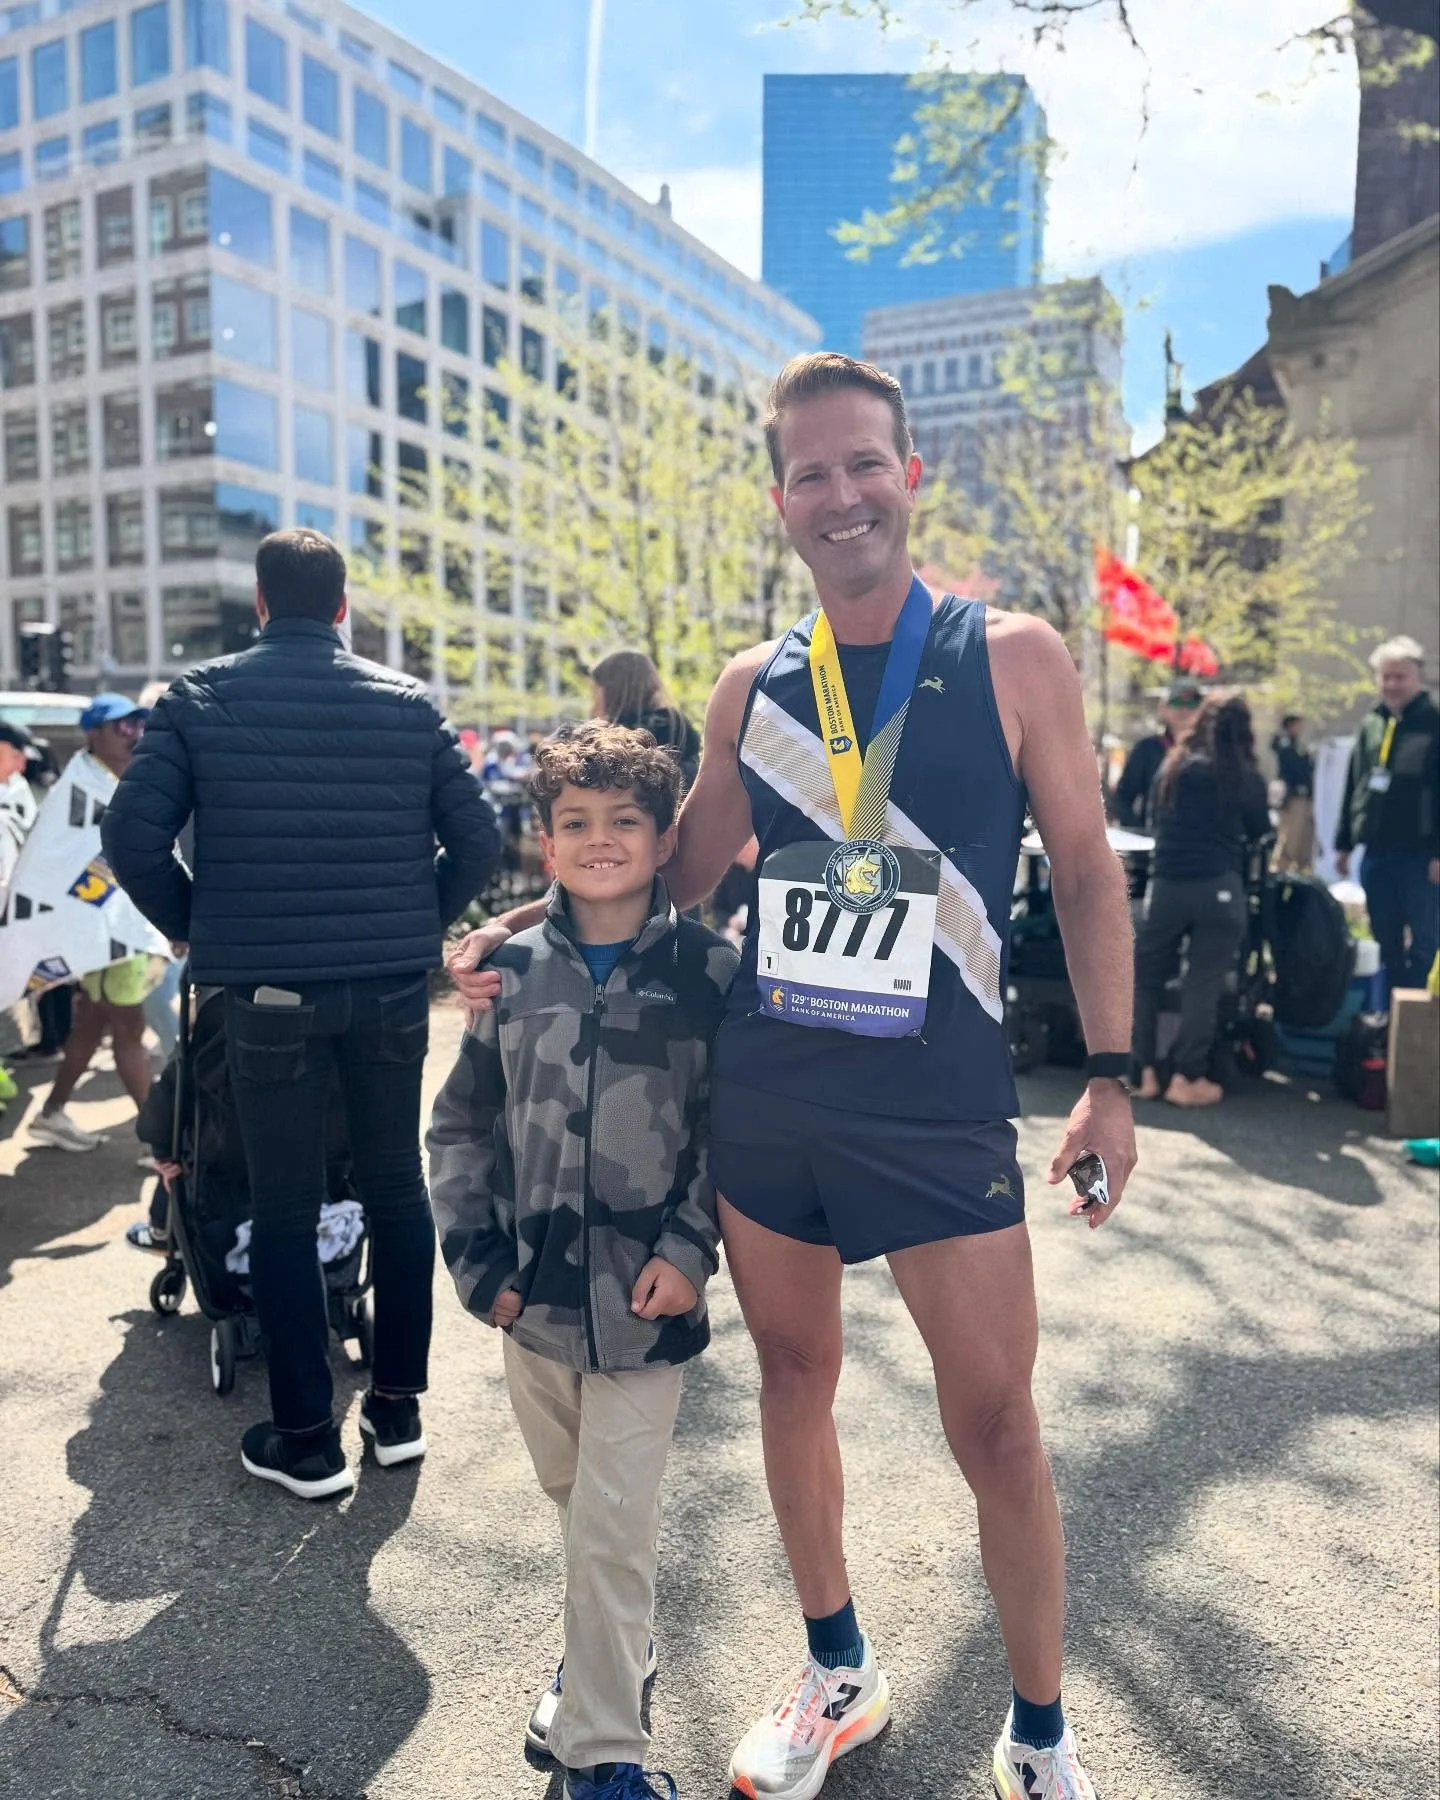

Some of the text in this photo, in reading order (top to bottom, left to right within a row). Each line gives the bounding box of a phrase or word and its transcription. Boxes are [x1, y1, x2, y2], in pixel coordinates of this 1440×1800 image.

[818, 664, 838, 735] BOSTON MARATHON
[838, 841, 864, 855] BOSTON
[866, 841, 897, 866] MARATHON
[783, 888, 909, 961] 8777
[766, 956, 772, 969] 1
[645, 990, 674, 1001] Columbia
[791, 1005, 811, 1015] BANK
[821, 1011, 856, 1022] AMERICA
[810, 997, 848, 1012] BOSTON
[850, 1003, 910, 1019] MARATHON
